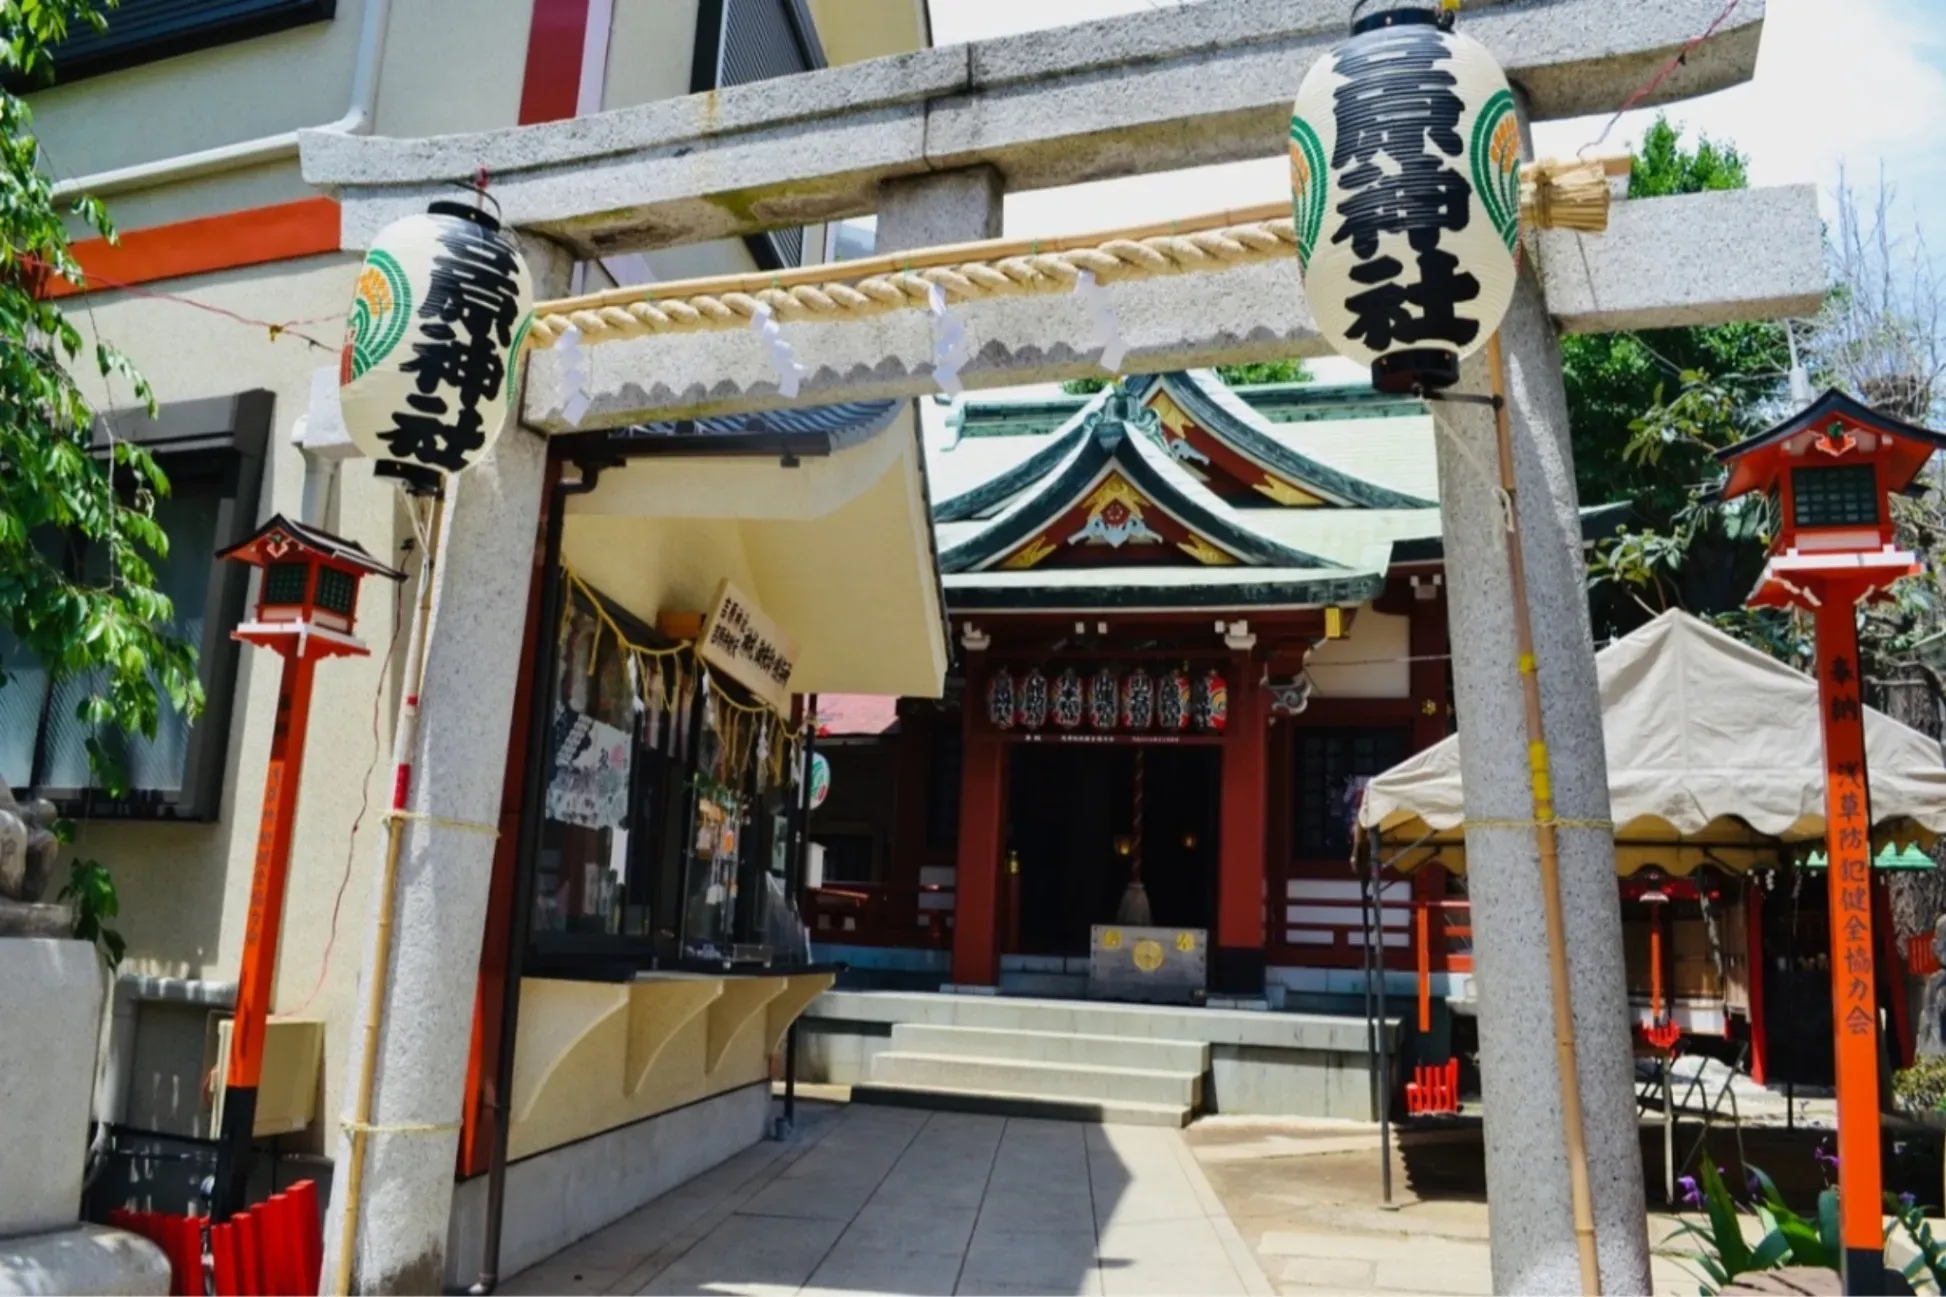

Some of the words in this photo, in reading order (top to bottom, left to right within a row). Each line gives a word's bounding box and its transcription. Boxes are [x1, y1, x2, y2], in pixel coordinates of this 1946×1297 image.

[1331, 25, 1480, 347] 吉原神社
[376, 214, 520, 473] 吉原神社
[1829, 654, 1858, 723] 奉納
[1837, 761, 1875, 1036] 浅草防犯健全協力会
